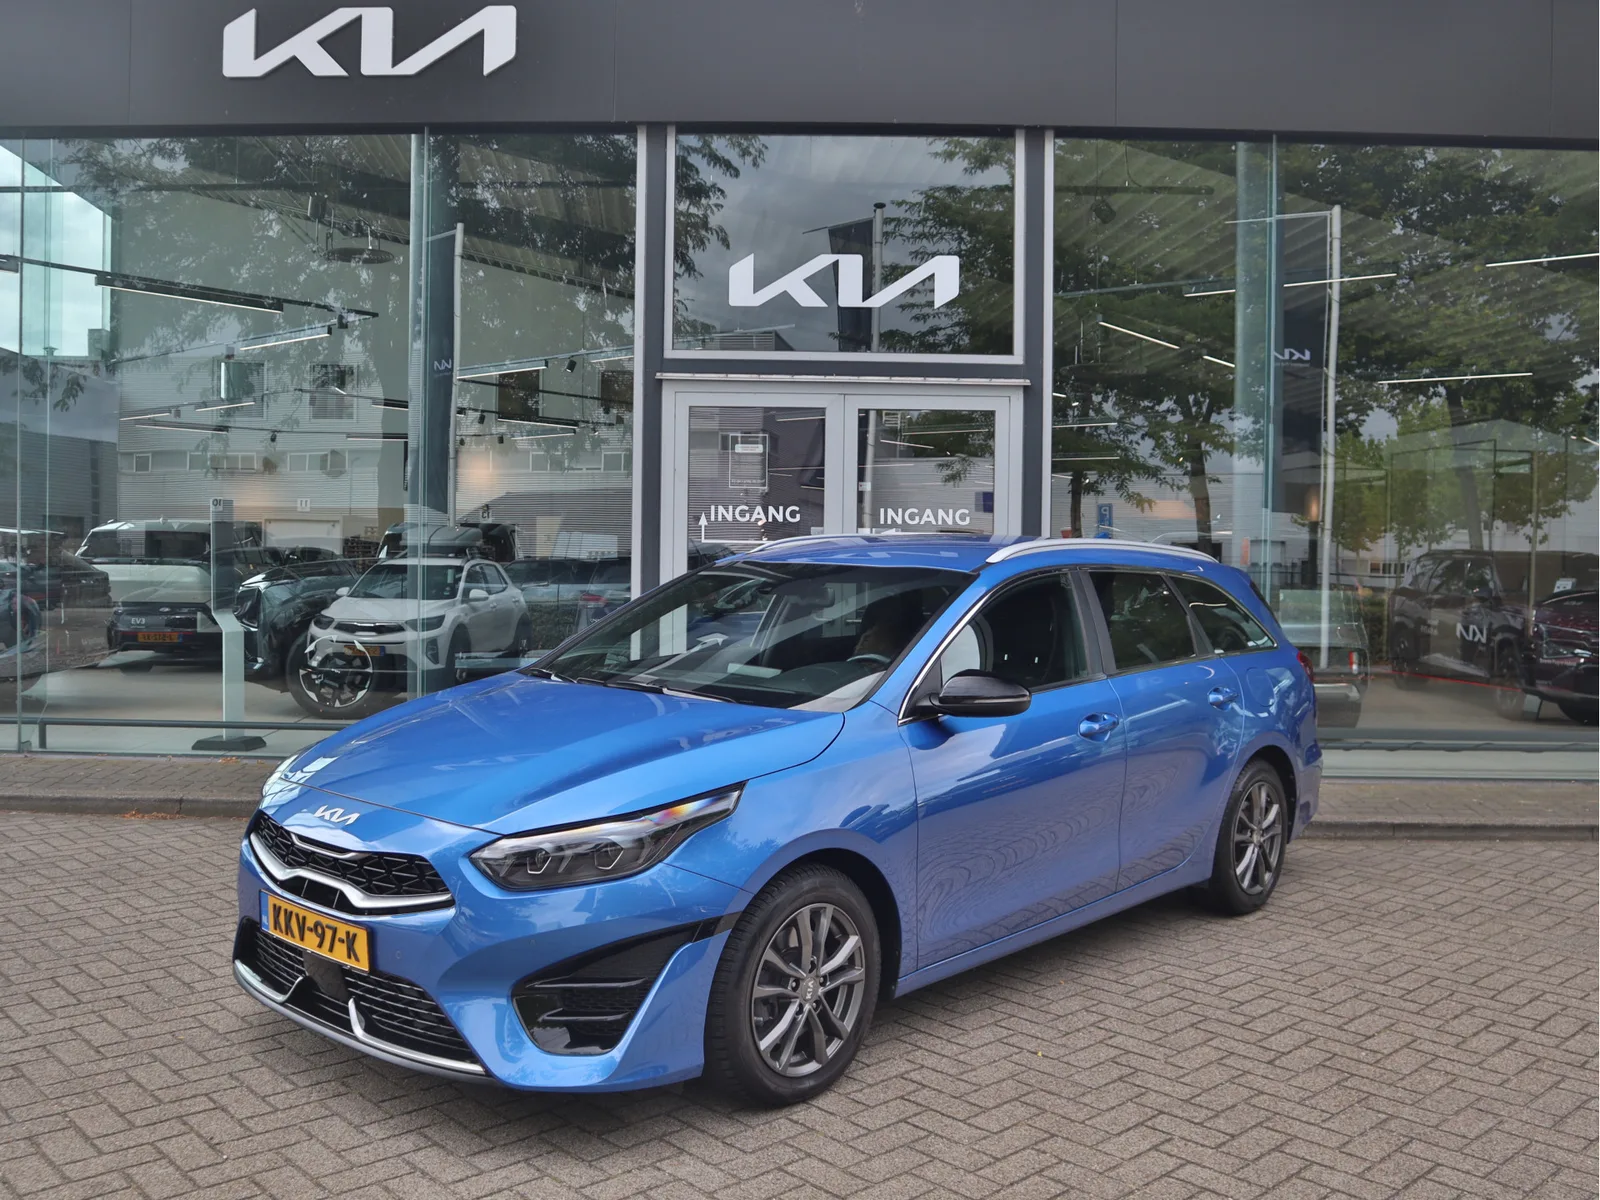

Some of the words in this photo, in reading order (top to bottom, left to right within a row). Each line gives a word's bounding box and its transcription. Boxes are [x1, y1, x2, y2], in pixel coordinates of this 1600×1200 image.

[222, 4, 517, 77] KIA
[728, 252, 960, 310] KIA
[710, 504, 801, 523] INGANG
[879, 507, 971, 526] INGANG
[130, 617, 146, 625] EV3
[313, 804, 360, 826] KIA
[272, 903, 360, 962] KKV-97-K
[805, 980, 815, 999] KIA
